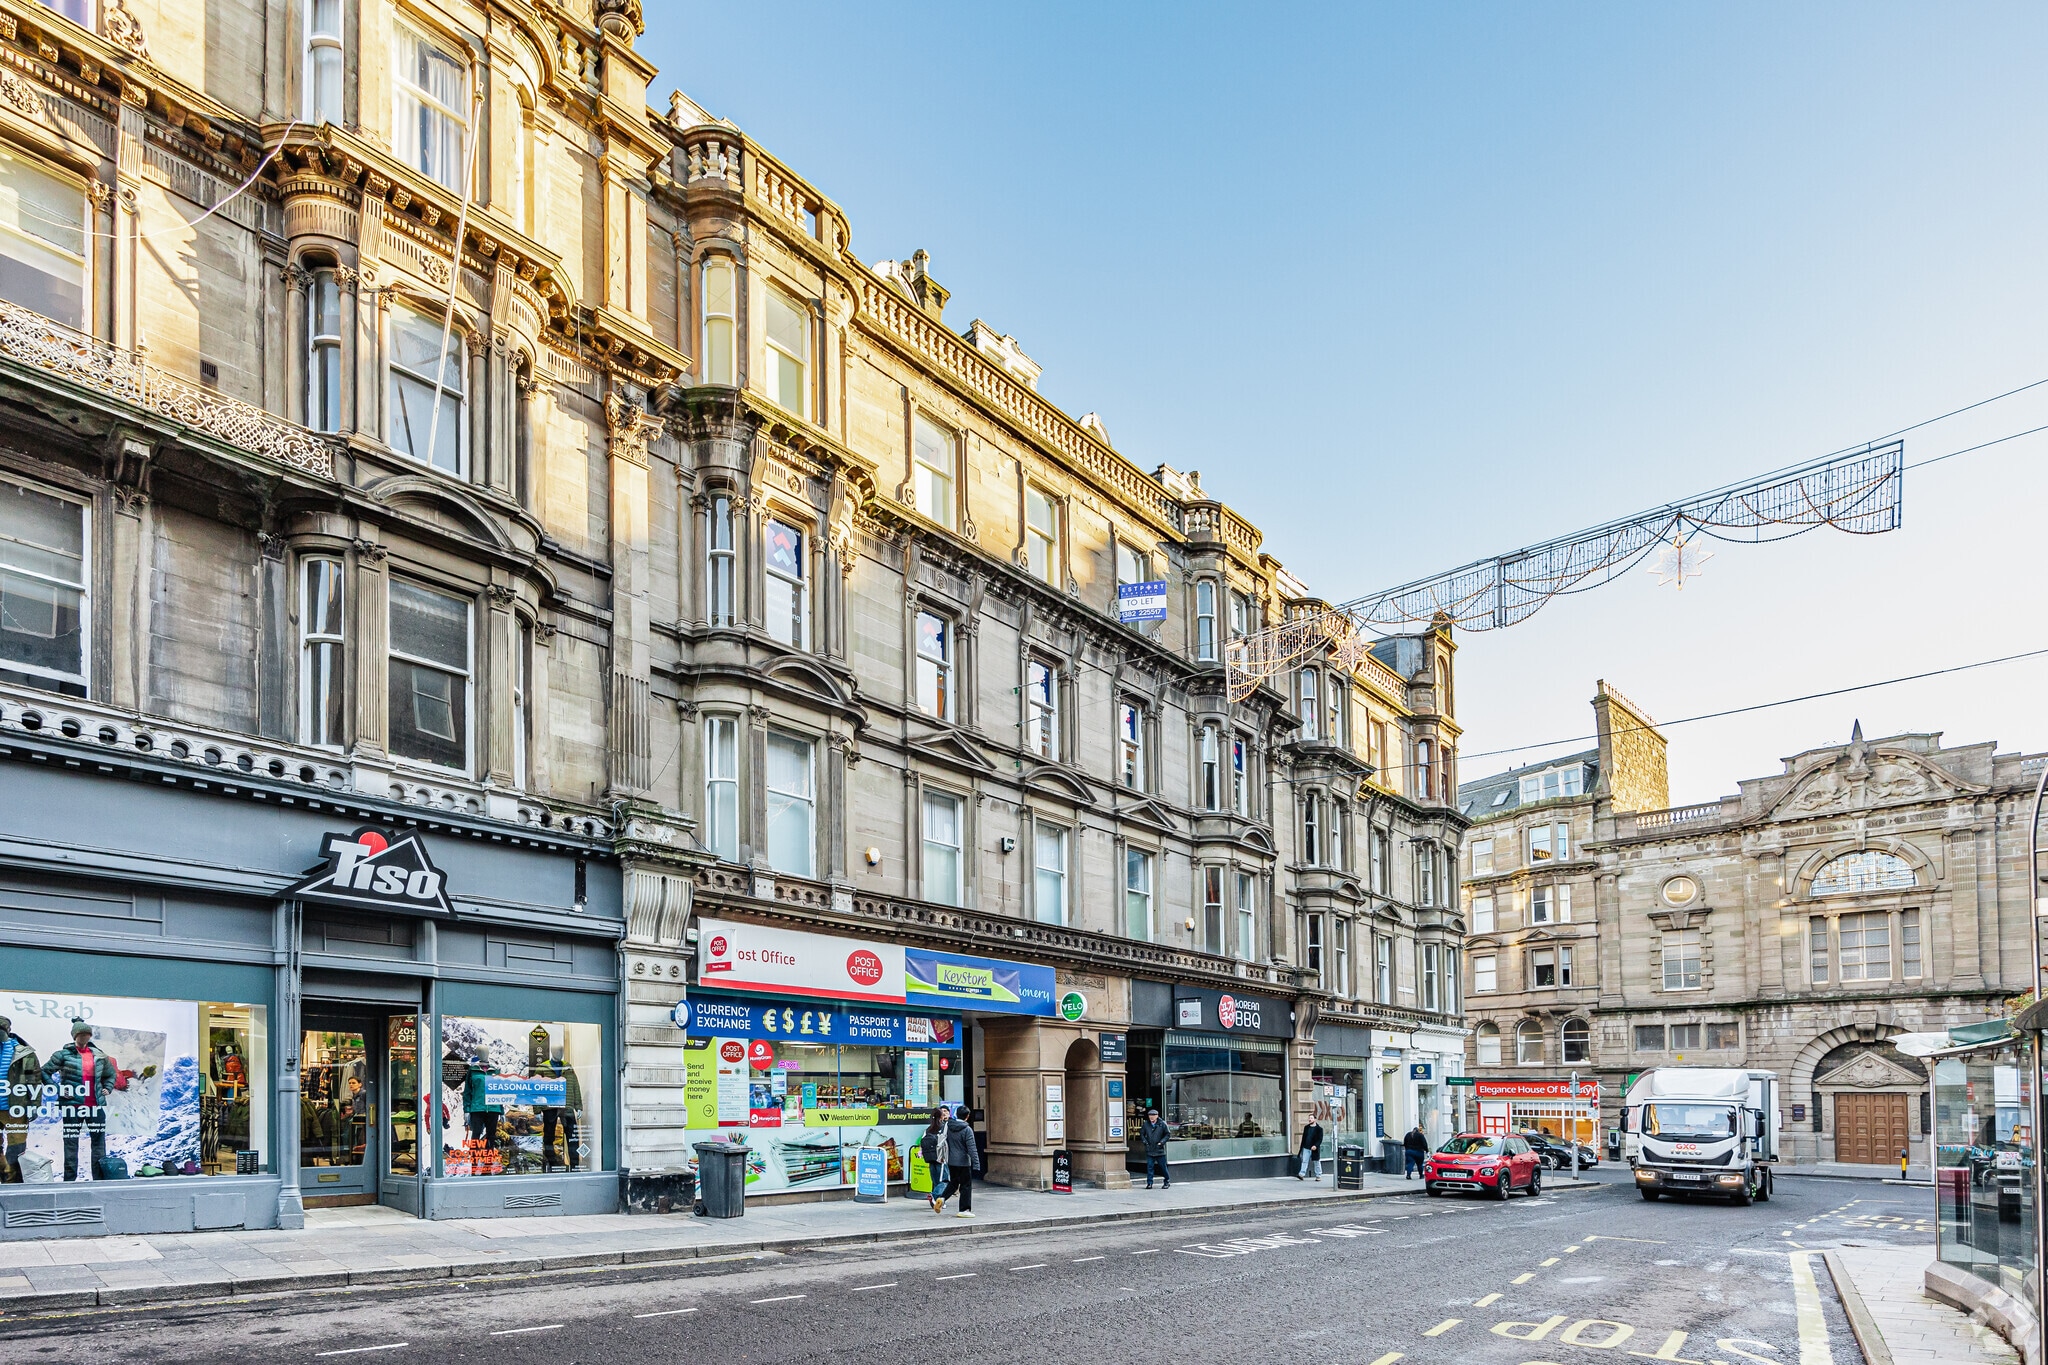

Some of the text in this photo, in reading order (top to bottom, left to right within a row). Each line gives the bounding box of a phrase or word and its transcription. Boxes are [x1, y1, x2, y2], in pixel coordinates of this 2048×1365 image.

[1140, 597, 1154, 605] LET
[329, 838, 441, 899] Tiso
[737, 949, 796, 966] ost Office
[855, 956, 876, 968] POST
[850, 966, 879, 978] OFFICE
[943, 969, 987, 987] KeyStore
[40, 998, 94, 1019] Rab
[696, 1003, 751, 1017] CURRENCY
[1062, 1002, 1083, 1011] VELO
[696, 1016, 751, 1030] EXCHANGE
[849, 1015, 899, 1028] PASSPORT &
[1235, 1011, 1261, 1029] BBQ
[849, 1027, 892, 1038] ID PHOTOS
[0, 1080, 91, 1101] Beyond
[487, 1083, 564, 1092] SEASONAL OFFERS
[1480, 1085, 1517, 1095] Elegance
[1518, 1085, 1545, 1094] House
[1547, 1085, 1558, 1094] Of
[887, 1112, 931, 1121] Money Transfer
[462, 1138, 488, 1148] NEW
[449, 1149, 499, 1157] FOOTWEAR
[862, 1152, 881, 1161] EVRI
[445, 1156, 503, 1165] DEPARTMENT
